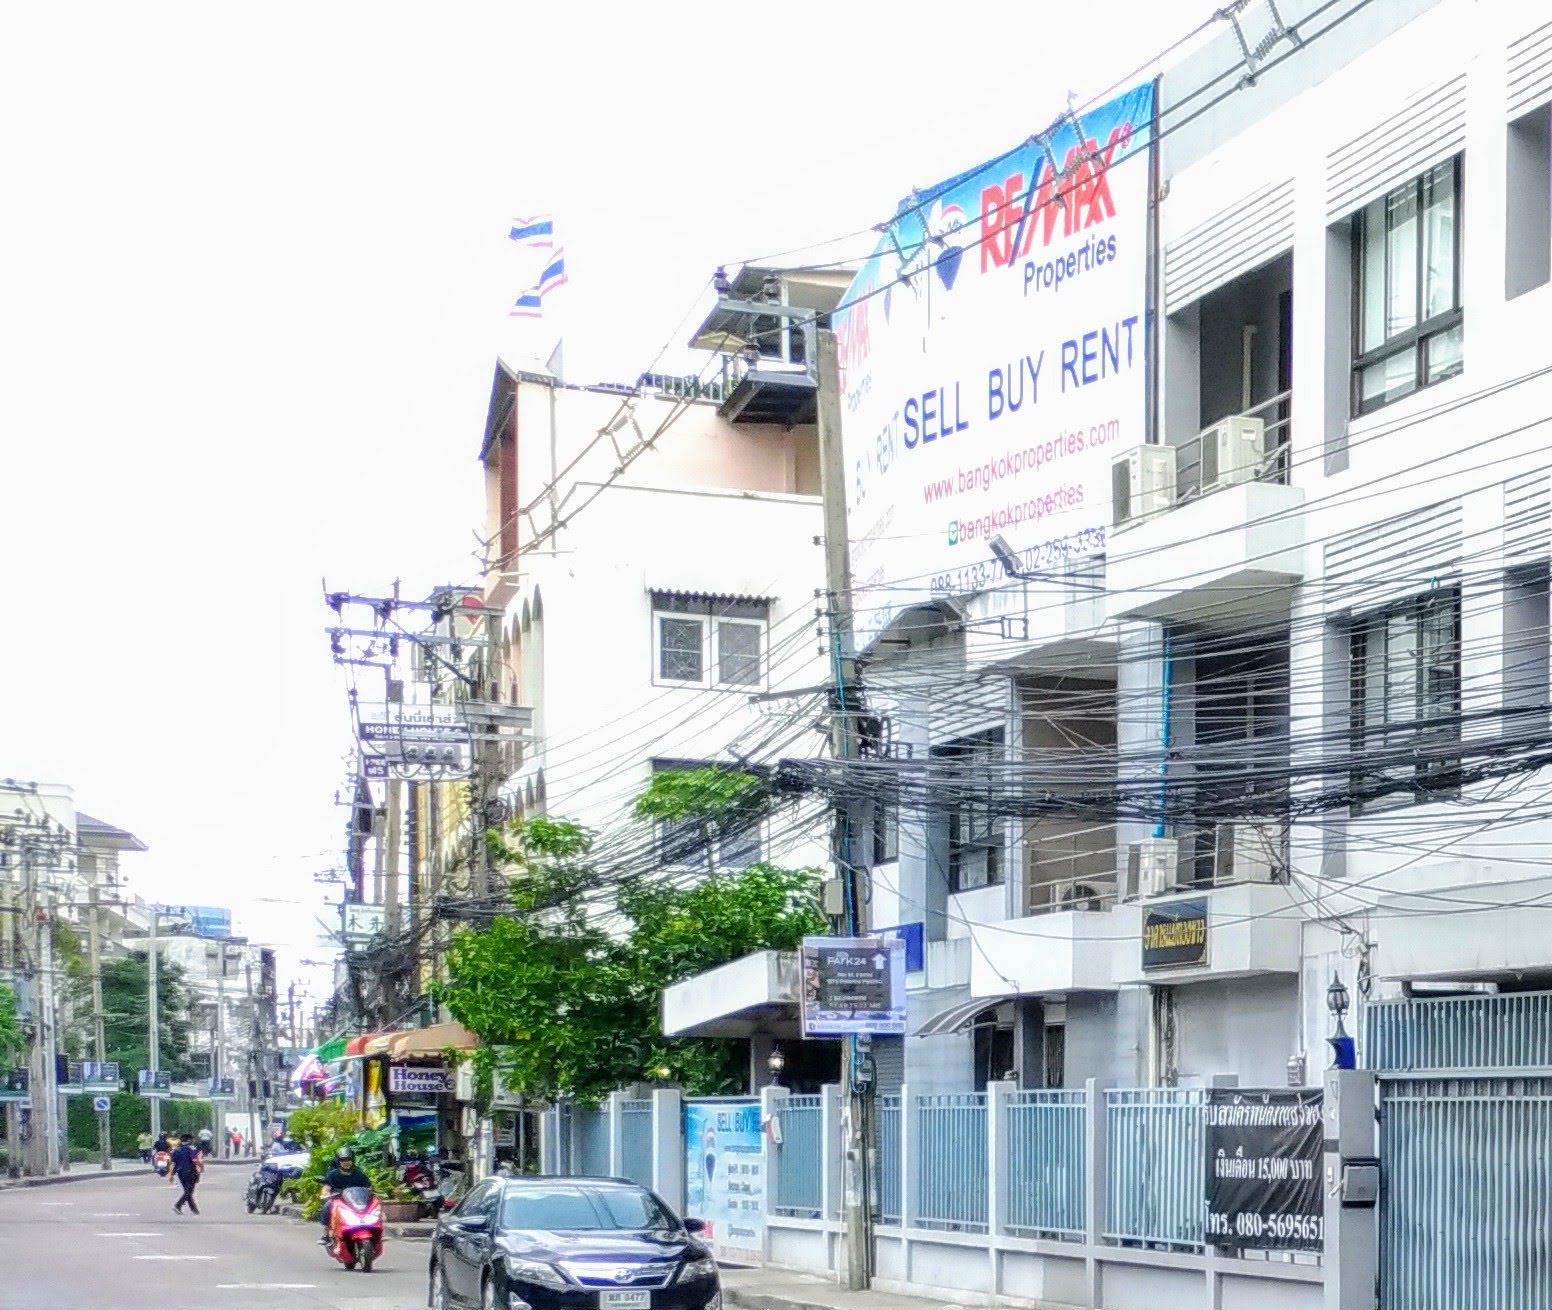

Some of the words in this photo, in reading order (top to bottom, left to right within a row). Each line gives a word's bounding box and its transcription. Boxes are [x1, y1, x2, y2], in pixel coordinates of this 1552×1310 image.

[979, 127, 1121, 275] RE/MAX
[1023, 233, 1117, 298] Properties
[904, 378, 969, 451] SELL
[989, 355, 1045, 421] BUY
[1062, 315, 1140, 393] RENT
[923, 417, 1120, 505] www.bangkokproperties.com
[959, 482, 1084, 542] bangkokproperties
[394, 1068, 446, 1083] Honey
[394, 1080, 443, 1091] House
[717, 1111, 732, 1132] SELL
[735, 1112, 749, 1132] BUY
[1215, 1146, 1256, 1179] เงินเดือน
[1257, 1157, 1289, 1184] 15,000
[1290, 1158, 1313, 1180] บาท
[1204, 1199, 1233, 1236] โทร.
[1236, 1211, 1324, 1240] 080-5695651
